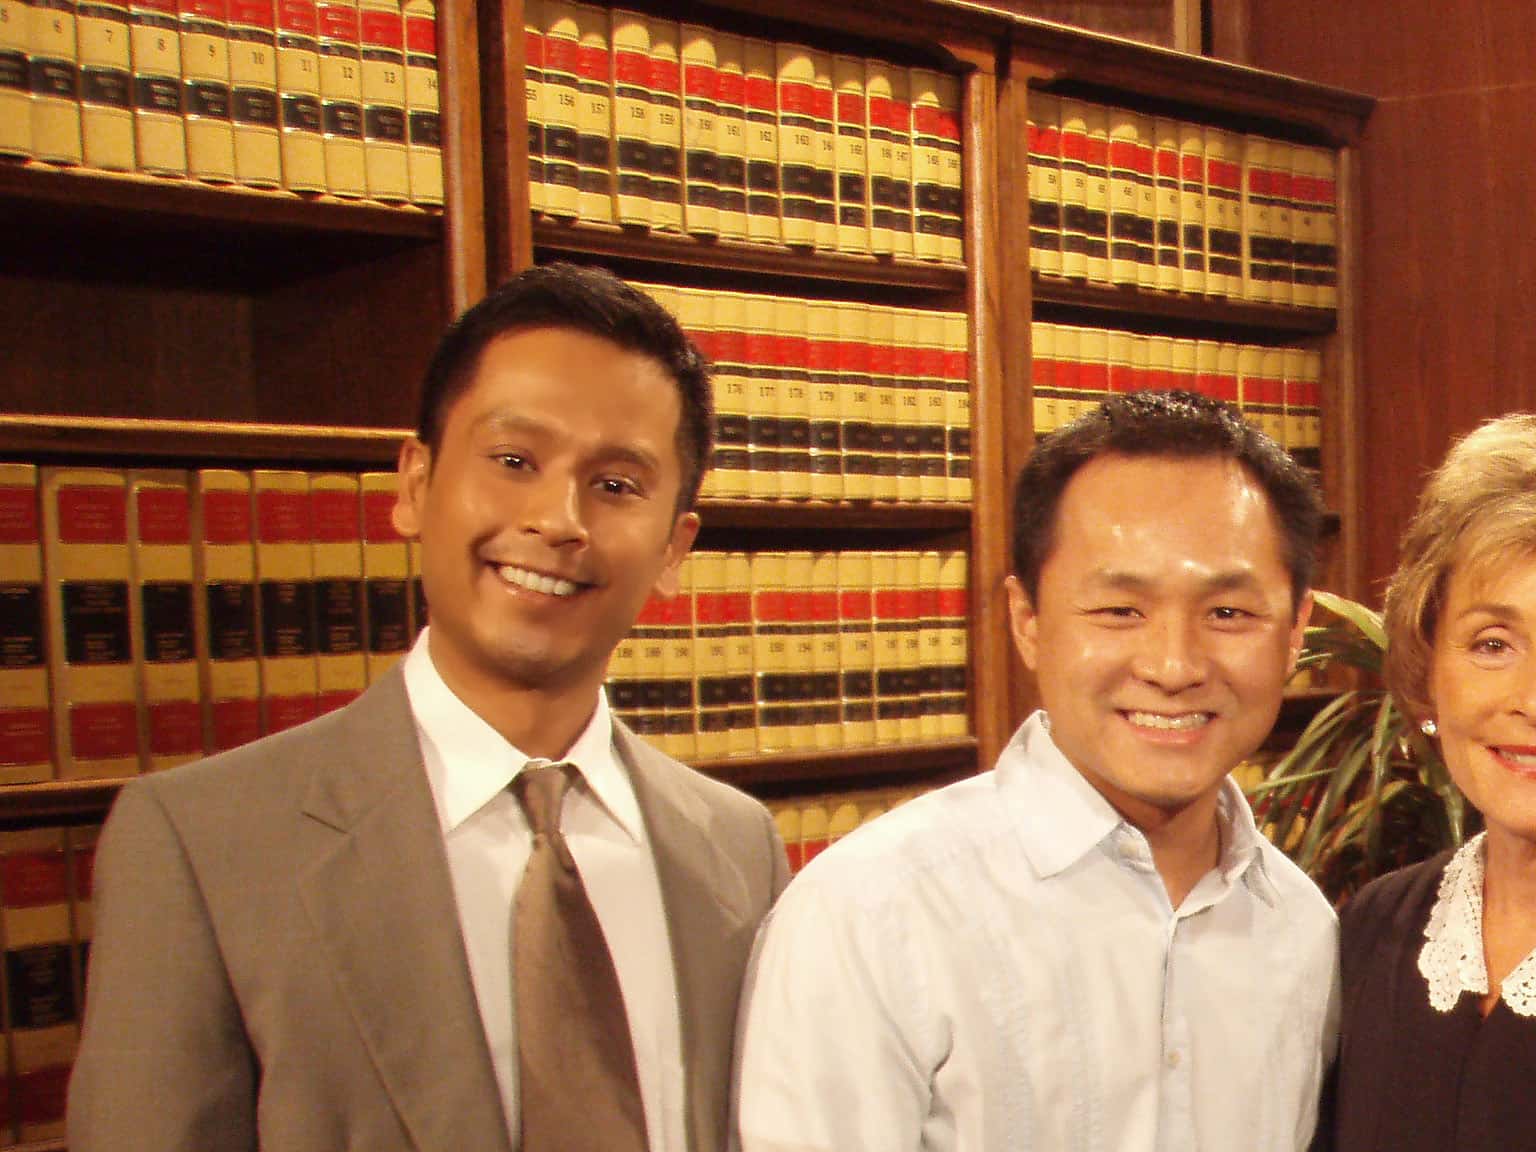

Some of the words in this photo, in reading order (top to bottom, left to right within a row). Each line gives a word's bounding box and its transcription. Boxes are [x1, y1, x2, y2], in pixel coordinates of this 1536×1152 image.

[252, 51, 264, 64] 10
[302, 59, 312, 72] 11
[343, 67, 353, 79] 12
[384, 71, 396, 84] 13
